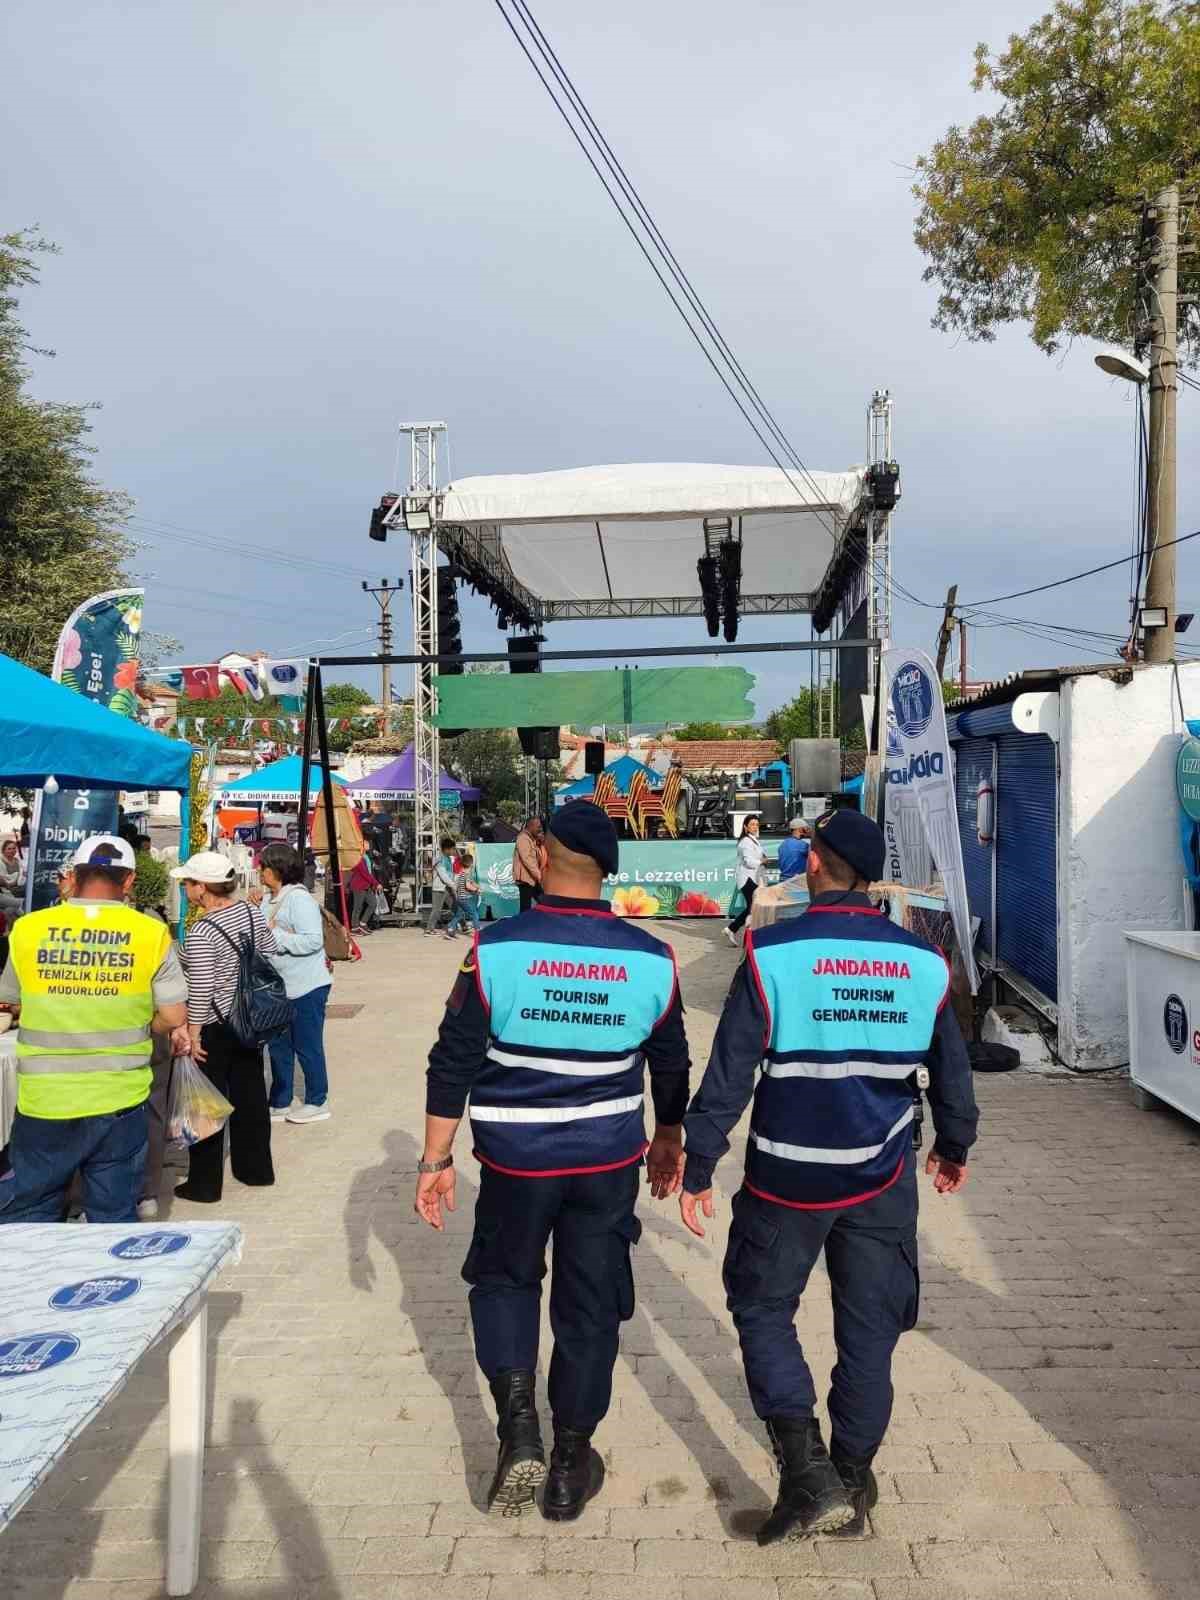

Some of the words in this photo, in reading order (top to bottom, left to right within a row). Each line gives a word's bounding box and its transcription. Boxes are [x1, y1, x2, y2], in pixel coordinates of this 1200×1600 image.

[635, 868, 718, 883] Lezzetleri
[48, 927, 77, 943] T.C.
[37, 968, 92, 981] TEMİZLİK
[95, 970, 132, 984] İŞLERİ
[527, 959, 628, 982] JANDARMA
[812, 958, 911, 979] JANDARMA
[543, 989, 609, 1006] TOURISM
[831, 988, 895, 1003] TOURISM
[520, 1007, 627, 1026] GENDARMERIE
[812, 1008, 909, 1024] GENDARMERIE
